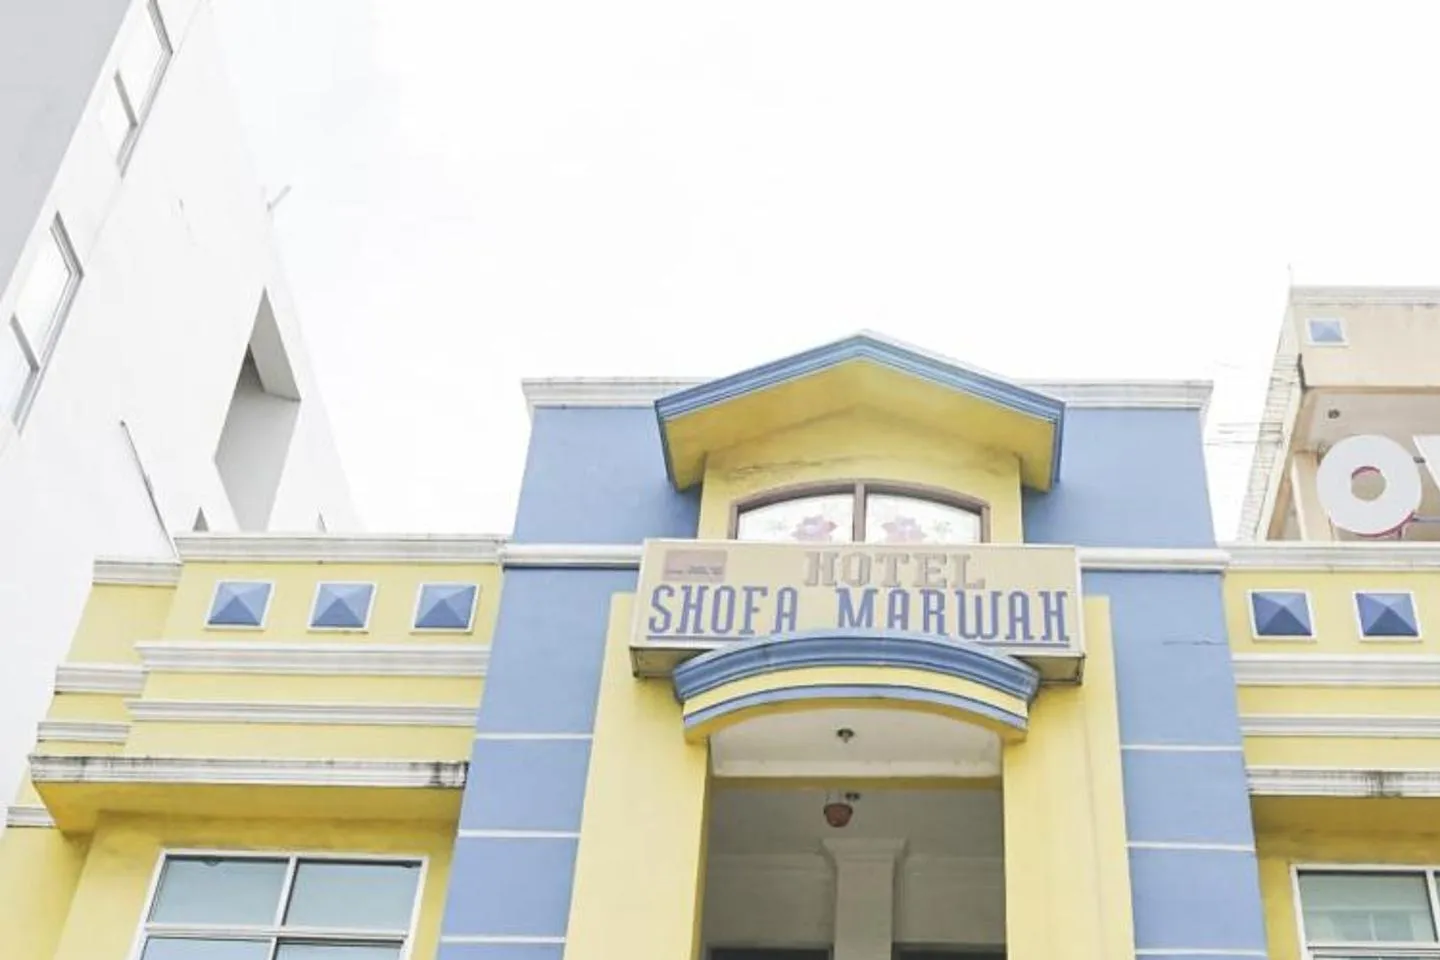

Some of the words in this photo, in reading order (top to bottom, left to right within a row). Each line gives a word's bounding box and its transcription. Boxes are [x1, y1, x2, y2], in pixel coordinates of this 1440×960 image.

[803, 551, 985, 589] HOTEL
[648, 584, 798, 635] SHOFA
[835, 587, 1070, 642] MARWAH
